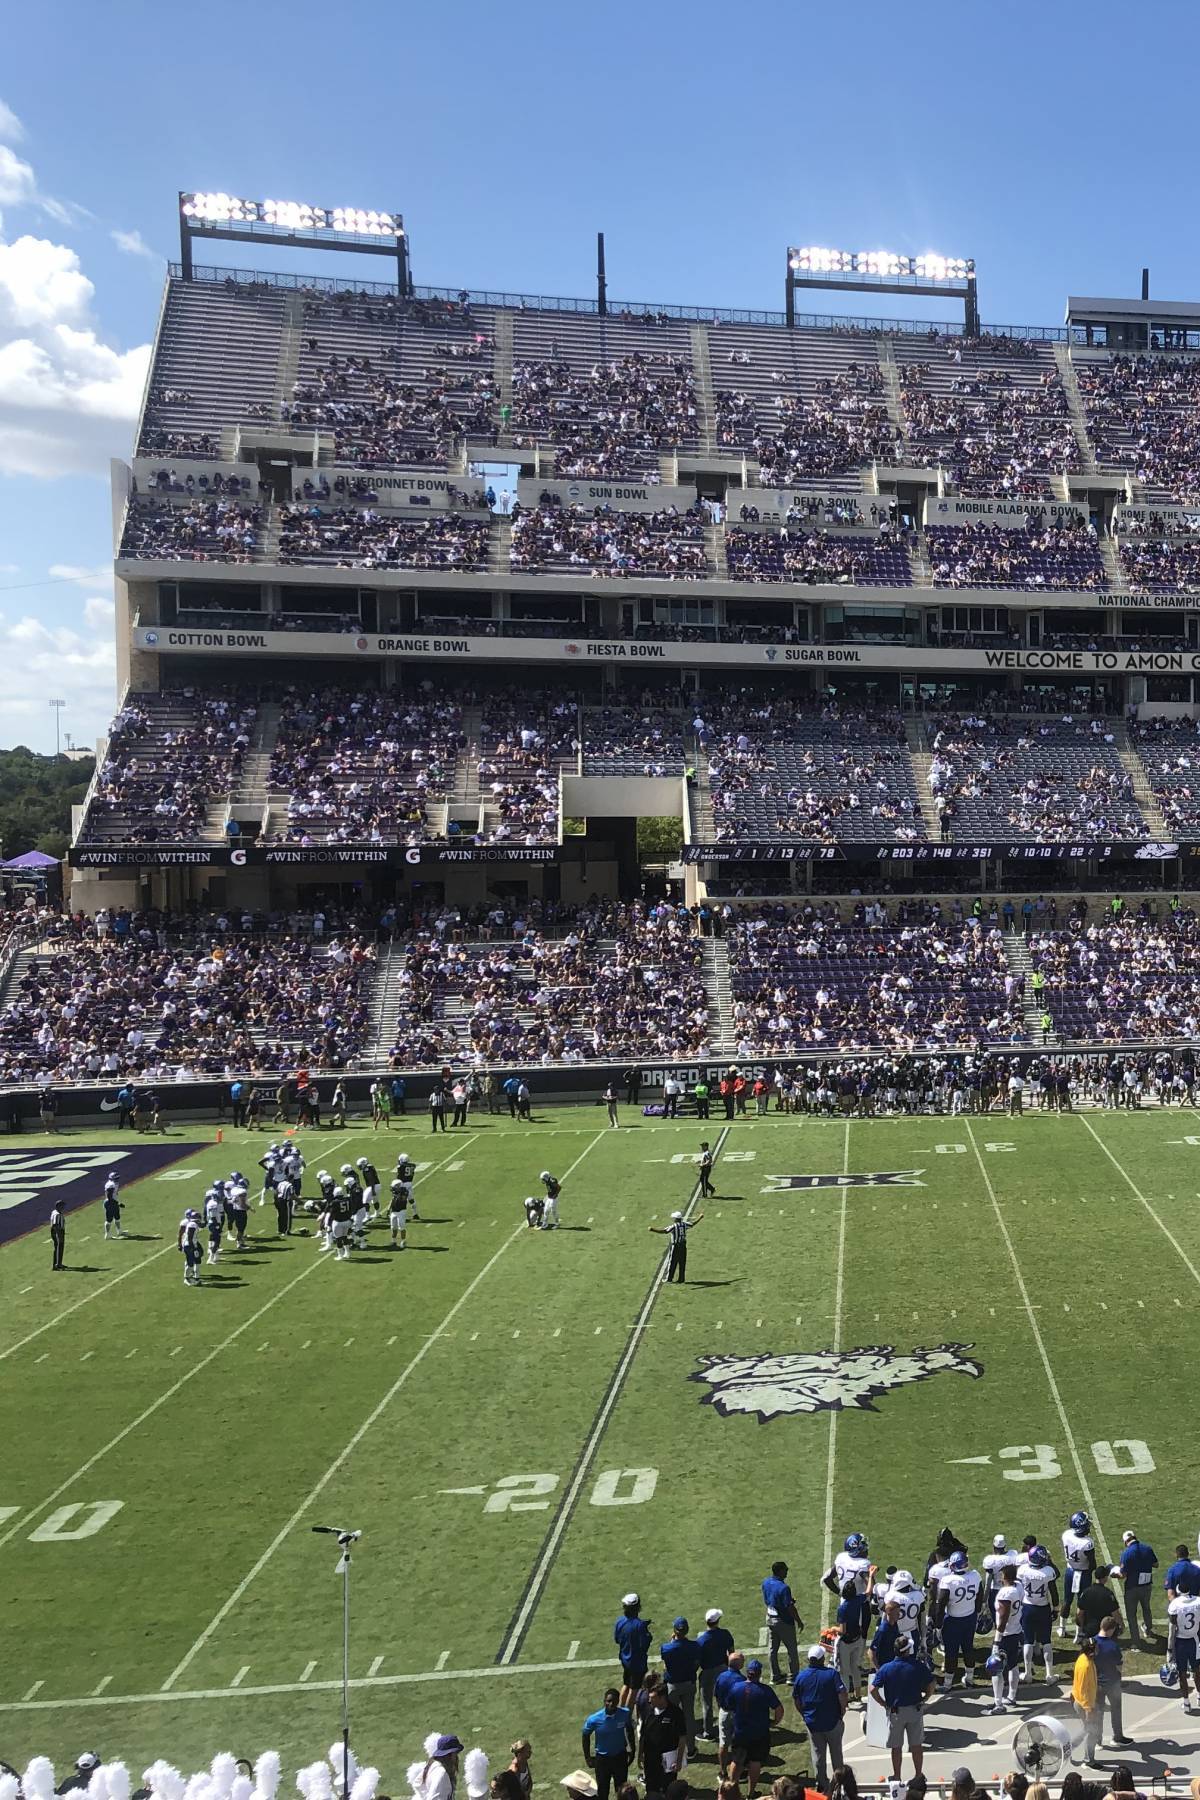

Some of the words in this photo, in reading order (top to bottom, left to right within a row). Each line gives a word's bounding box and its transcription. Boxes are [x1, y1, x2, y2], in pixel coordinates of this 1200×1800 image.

[589, 487, 612, 499] SUN
[616, 489, 648, 500] BOWL
[794, 496, 824, 507] DELTA
[829, 498, 860, 508] BOWL
[956, 503, 993, 514] MOBILE
[996, 504, 1048, 516] ALABAMA
[1050, 506, 1080, 517] BOWL
[1121, 510, 1146, 519] HOME
[1162, 512, 1178, 520] THE
[1098, 596, 1151, 608] NATIONAL
[168, 633, 223, 646] COTTON
[227, 634, 268, 647] BOWL
[378, 638, 430, 651] ORANGE
[433, 640, 470, 652] BOWL
[587, 644, 626, 656] FIESTA
[630, 646, 666, 656] BOWL
[785, 650, 824, 660] SUGAR
[828, 650, 862, 662] BOWL
[985, 651, 1084, 668] WELCOME
[1092, 653, 1118, 669] TO
[1125, 654, 1183, 670] AMON
[752, 849, 757, 858] 1
[781, 848, 794, 858] 13
[820, 848, 835, 858] 78
[892, 848, 914, 858] 203
[932, 848, 952, 858] 148
[972, 848, 992, 858] 351
[1024, 848, 1052, 857] 10/10
[1070, 848, 1084, 856] 22
[998, 1438, 1158, 1482] 30
[482, 1467, 659, 1513] 20
[1065, 1545, 1080, 1560] 14
[954, 1584, 976, 1604] 95
[1024, 1582, 1046, 1598] 44
[1184, 1612, 1196, 1630] 3
